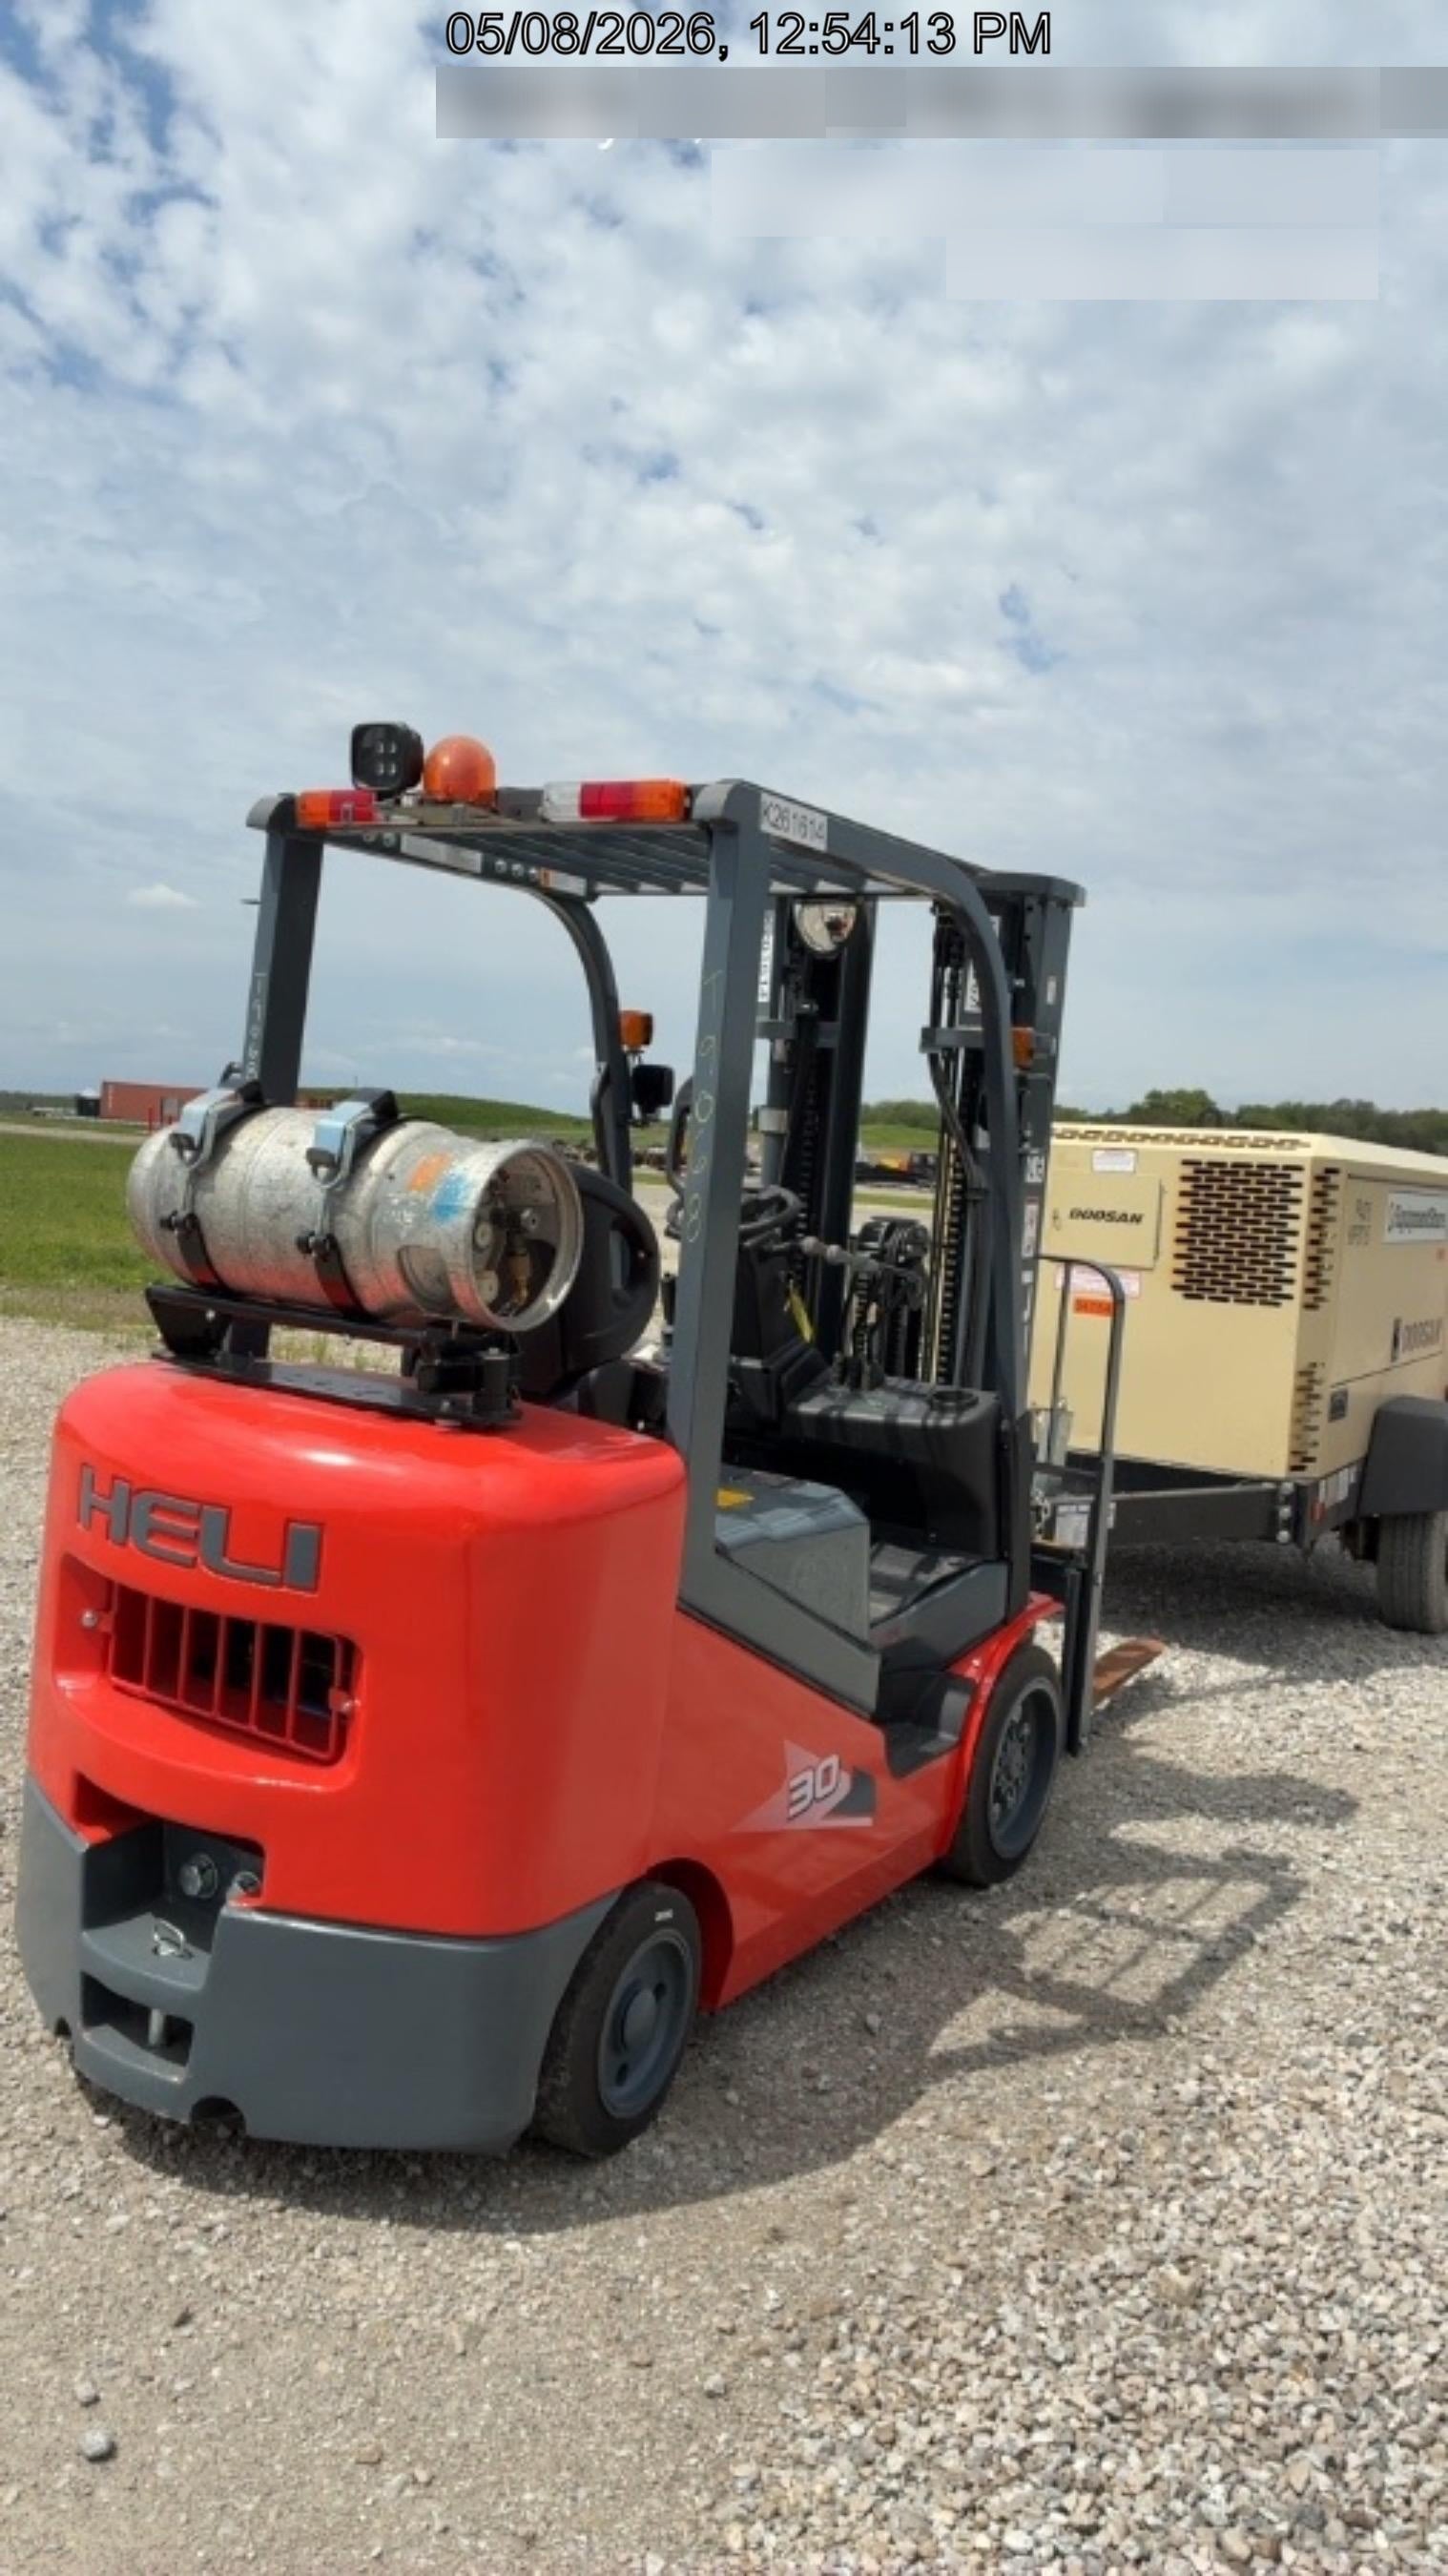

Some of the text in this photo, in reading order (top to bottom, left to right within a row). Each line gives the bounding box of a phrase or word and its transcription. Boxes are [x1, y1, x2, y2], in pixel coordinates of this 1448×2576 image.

[1069, 1207, 1145, 1225] DOOSAN
[78, 1463, 322, 1593] HELI
[788, 1754, 840, 1820] 30
